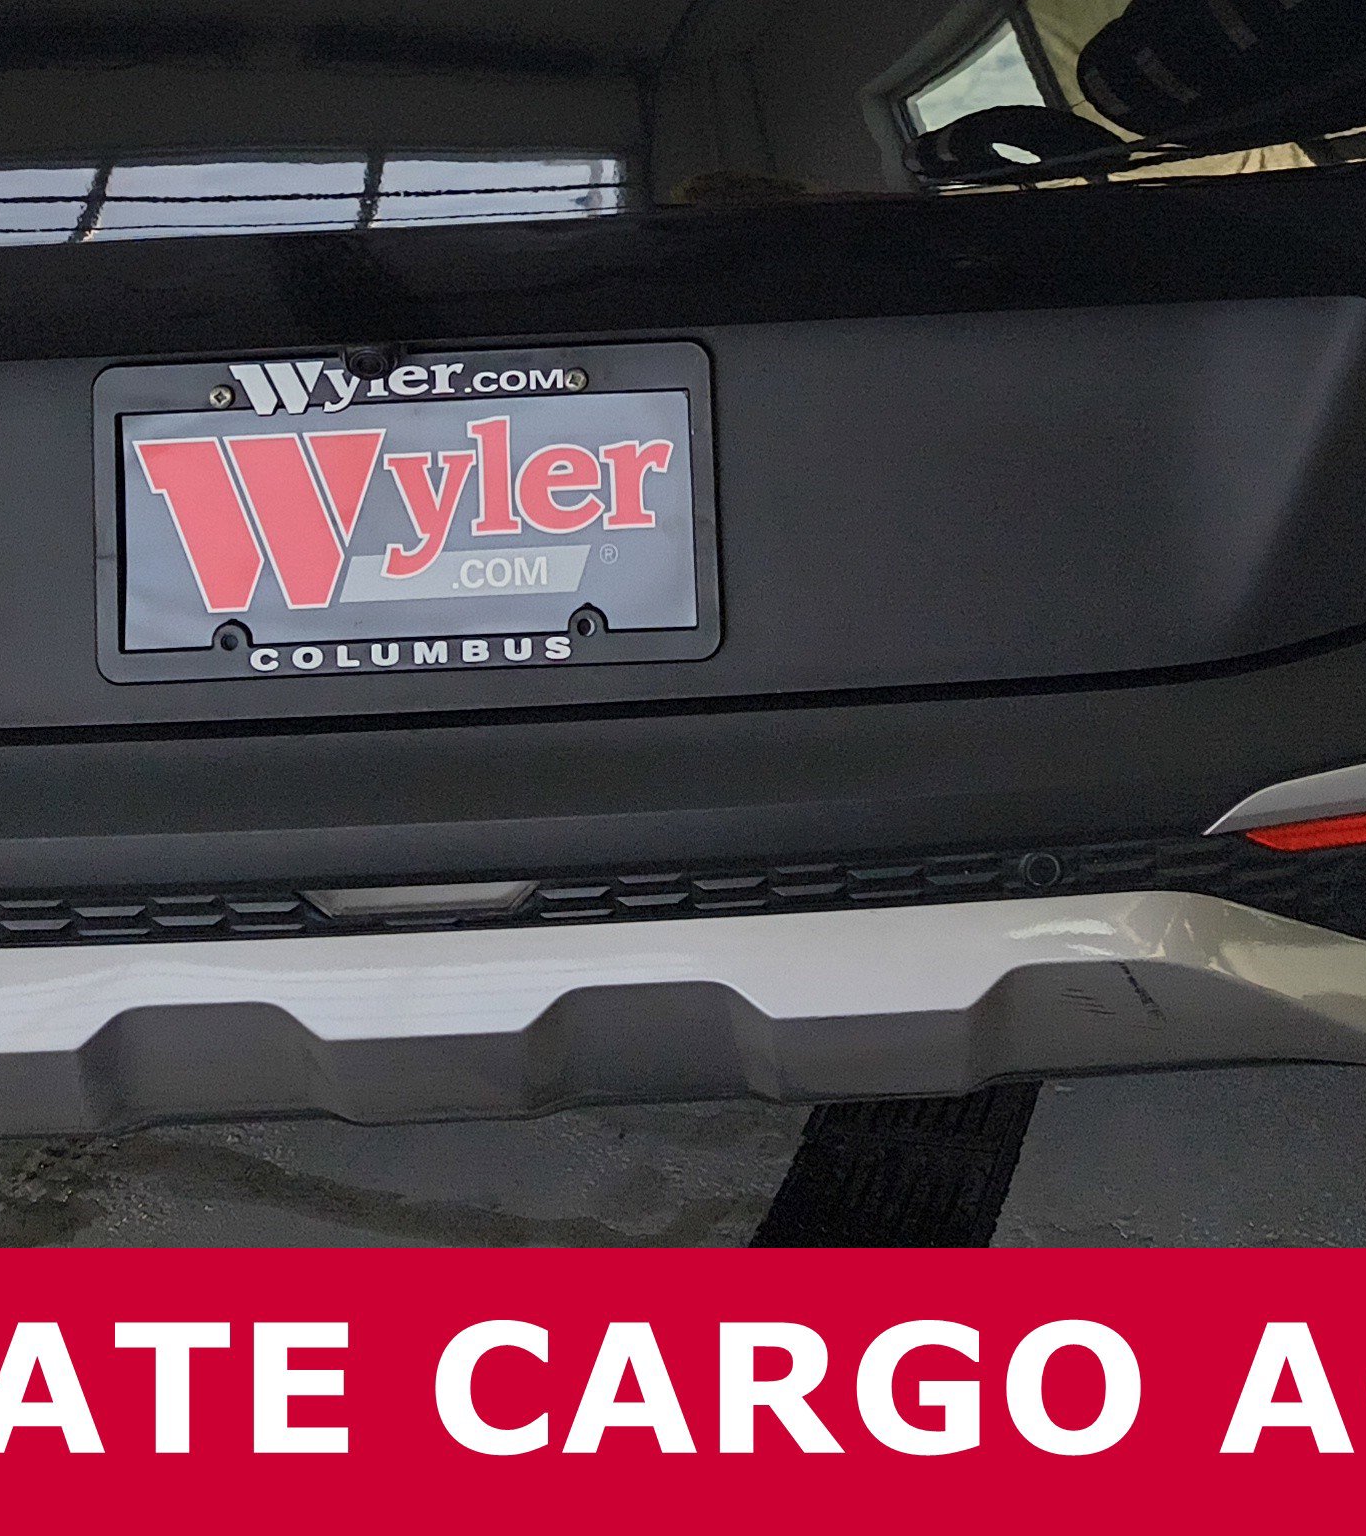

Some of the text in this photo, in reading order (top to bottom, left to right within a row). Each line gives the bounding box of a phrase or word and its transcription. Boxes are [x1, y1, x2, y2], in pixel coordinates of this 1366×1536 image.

[132, 414, 675, 614] Wyler
[451, 555, 549, 590] .COM
[249, 636, 572, 672] COLUMBUS
